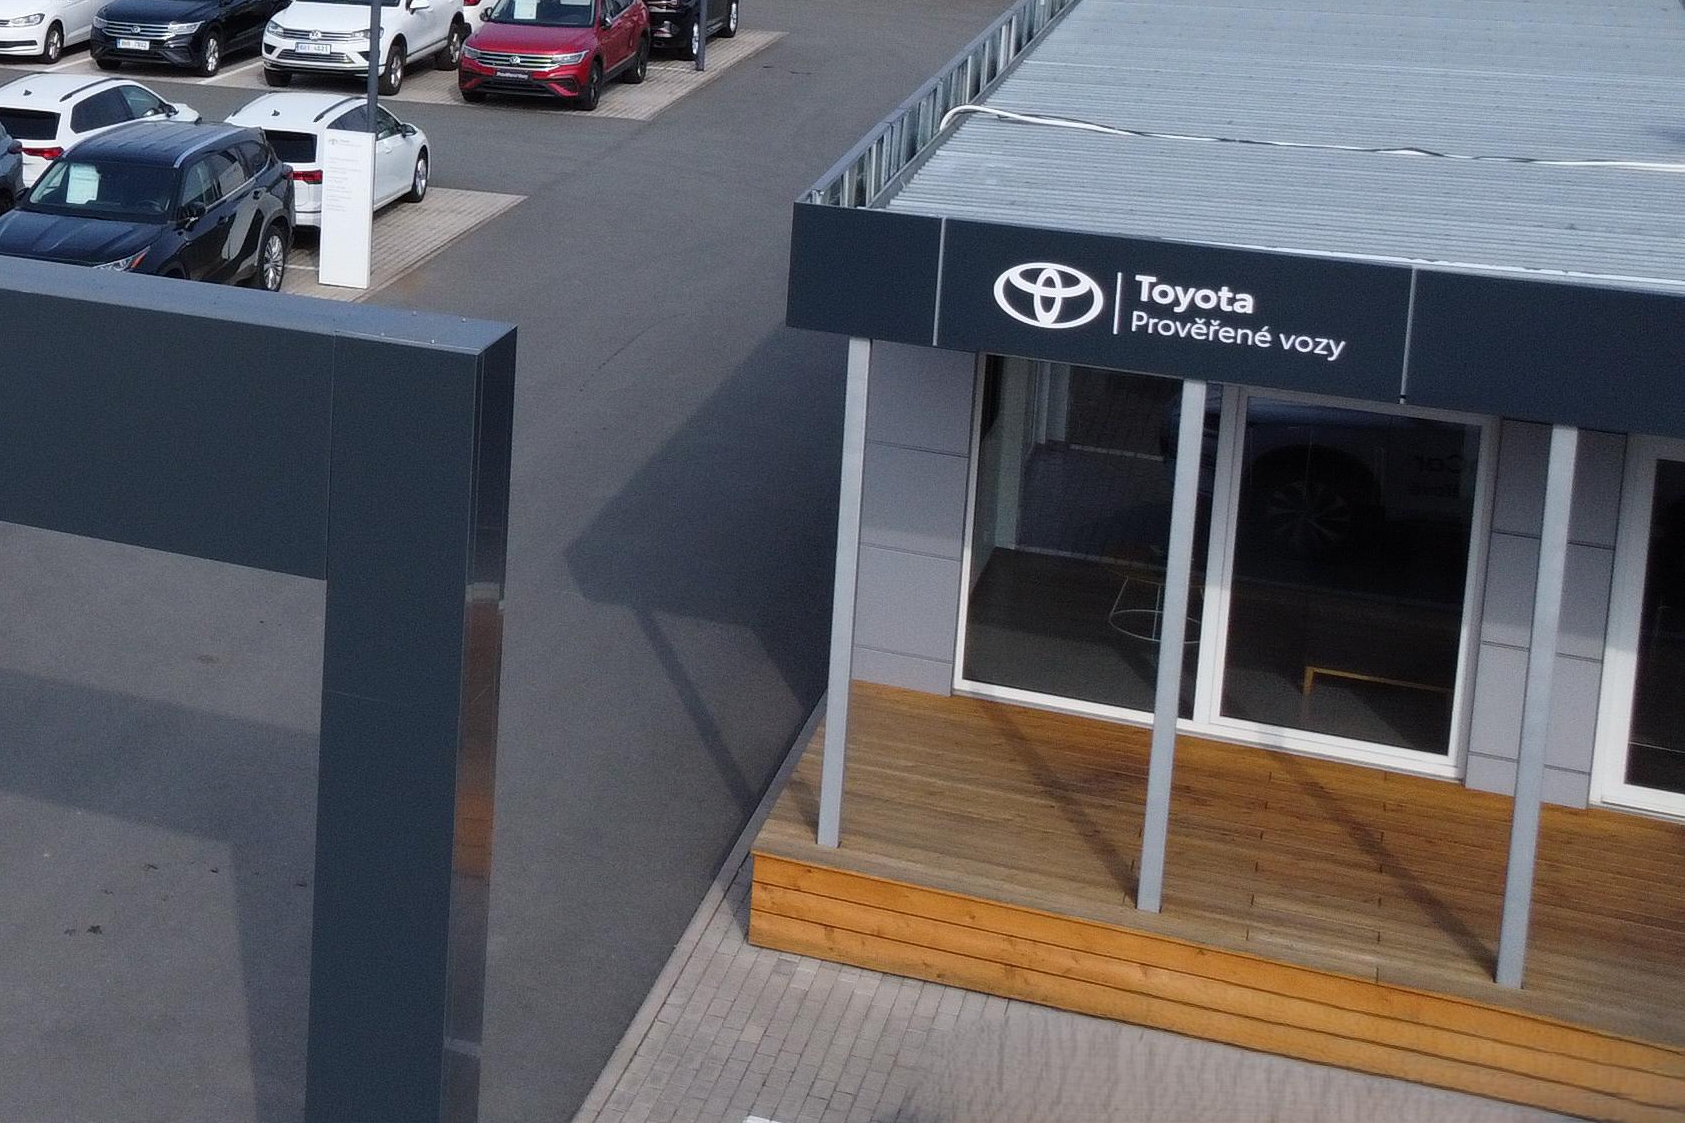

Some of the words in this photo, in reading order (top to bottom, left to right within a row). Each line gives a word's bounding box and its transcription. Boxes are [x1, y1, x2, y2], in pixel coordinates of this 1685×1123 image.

[1135, 274, 1254, 314] Toyota
[1131, 310, 1272, 348] Prověřené
[1279, 333, 1346, 362] vozy
